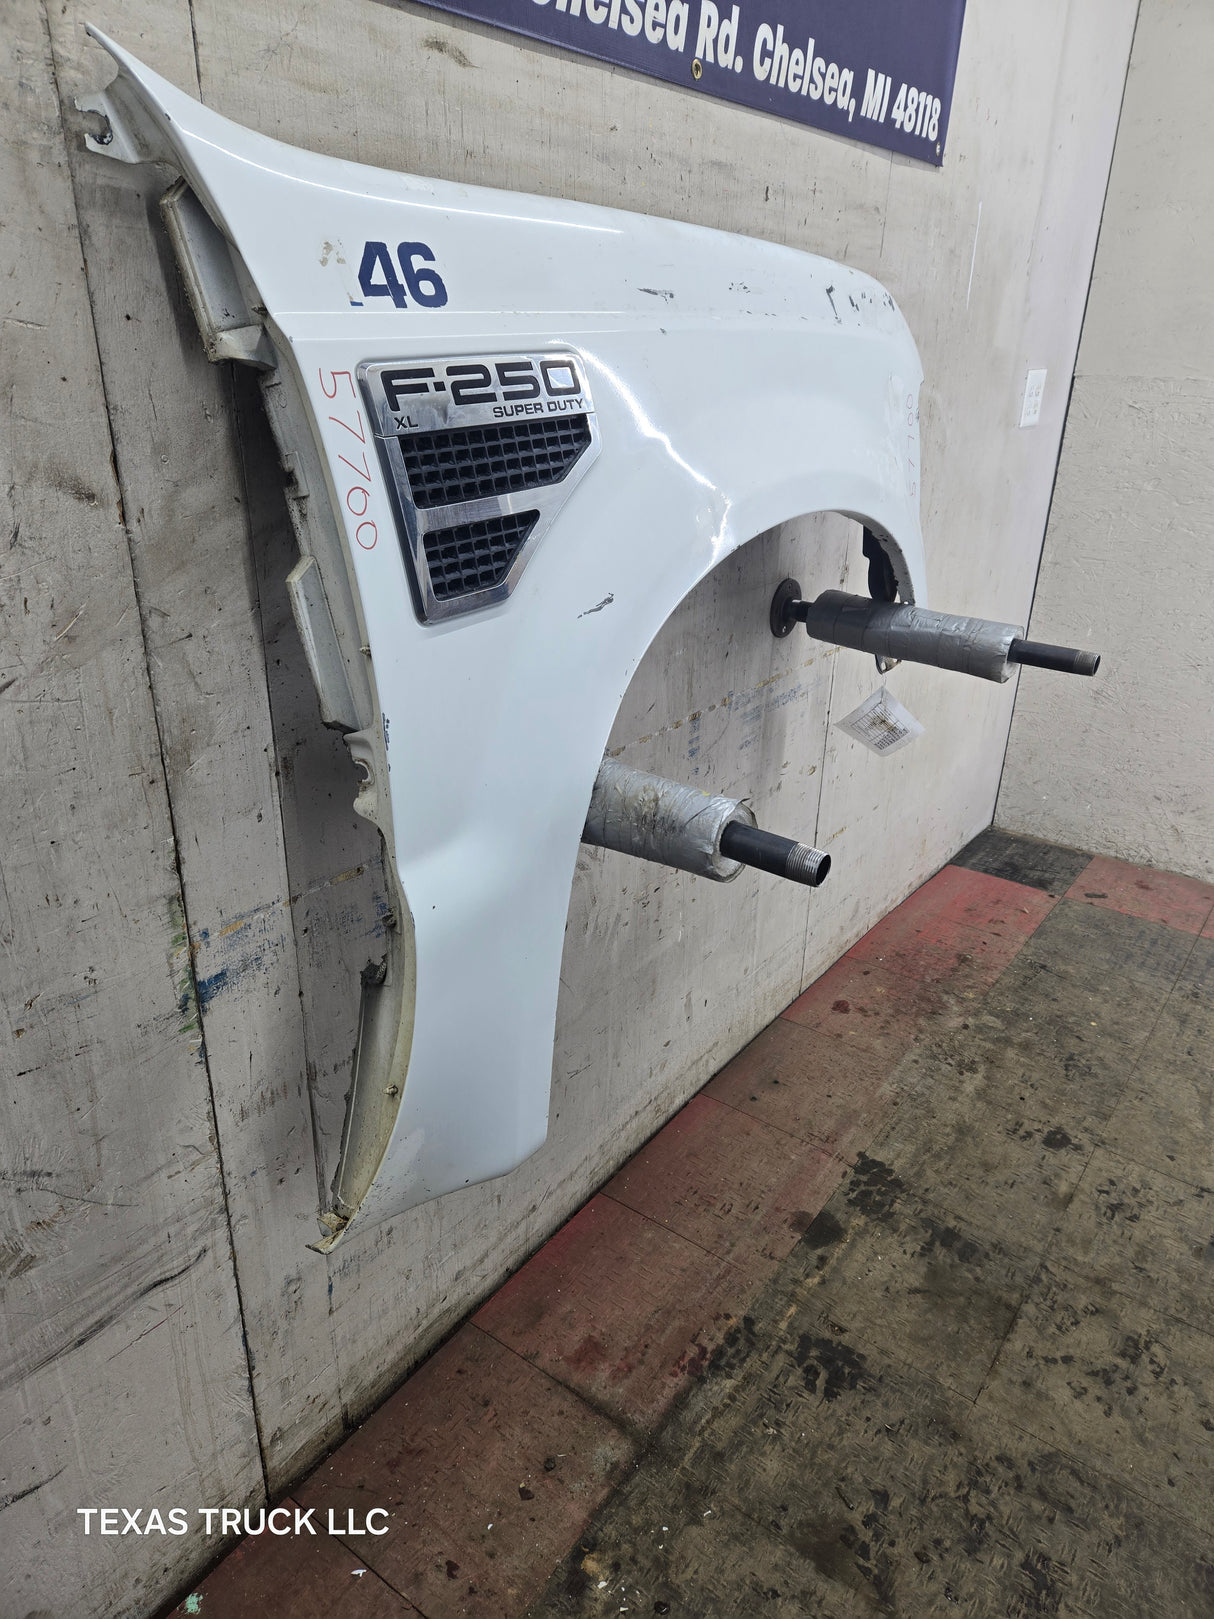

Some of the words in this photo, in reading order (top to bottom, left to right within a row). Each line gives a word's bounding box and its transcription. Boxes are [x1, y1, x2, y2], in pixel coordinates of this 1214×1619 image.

[532, 0, 689, 52] esea
[694, 0, 744, 73] Rd.
[753, 23, 855, 122] Chelsea,
[860, 68, 892, 123] MI
[891, 83, 941, 142] 48118
[358, 241, 448, 308] 46
[381, 360, 581, 411] F-250
[493, 402, 544, 418] SUPER
[549, 398, 583, 412] DUTY
[394, 416, 419, 430] XL
